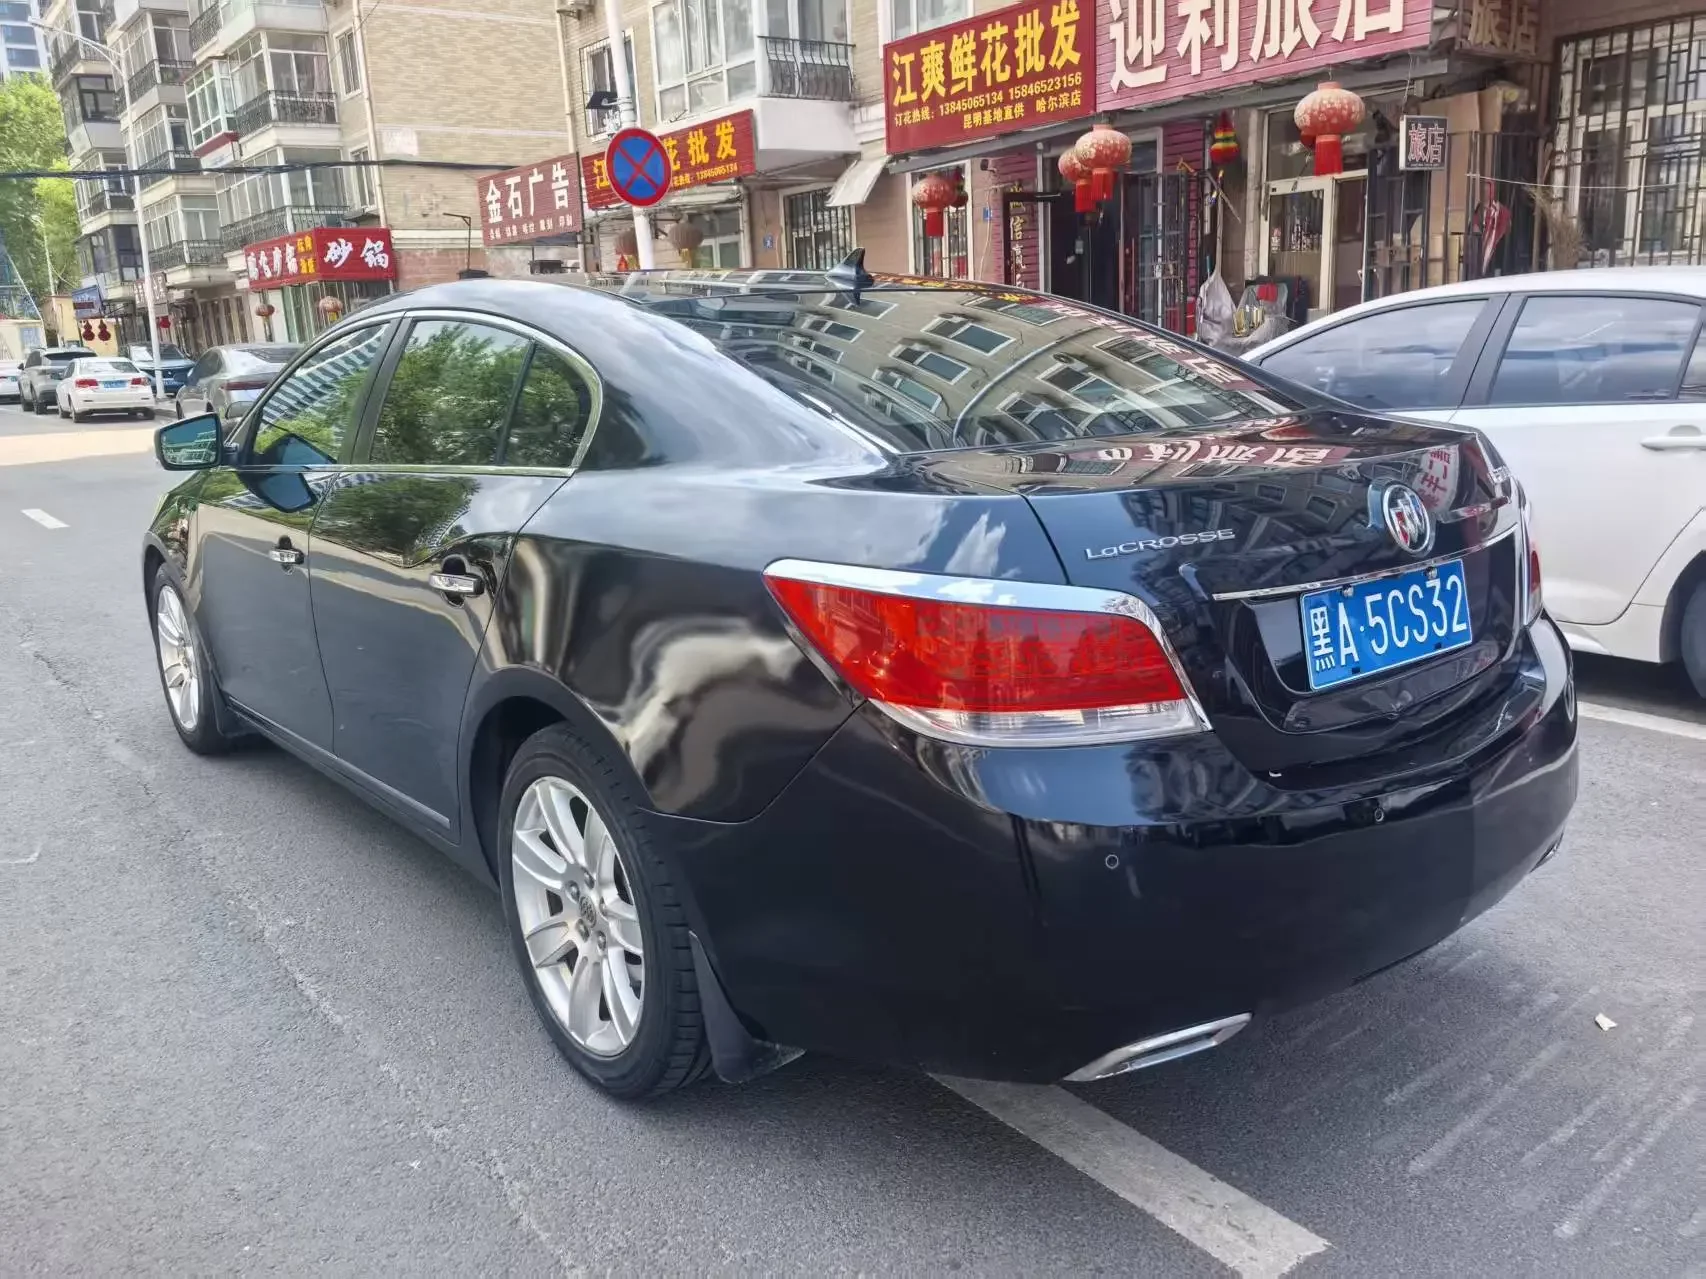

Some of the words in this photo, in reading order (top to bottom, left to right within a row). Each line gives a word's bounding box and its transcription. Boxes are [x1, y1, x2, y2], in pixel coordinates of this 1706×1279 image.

[893, 0, 1082, 106] 江爽鲜花批发
[939, 91, 1004, 116] 13845065134
[1008, 72, 1082, 100] 15846523156
[963, 103, 1025, 129] 昆明基地直供
[1036, 90, 1081, 113] 哈尔滨店
[593, 119, 737, 189] 江花批发
[1408, 123, 1444, 163] 旅店
[485, 161, 570, 224] 金石广告
[323, 237, 389, 269] 砂锅
[1085, 528, 1236, 560] LaCROSSE
[1310, 575, 1467, 671] 黑A·5CS32
